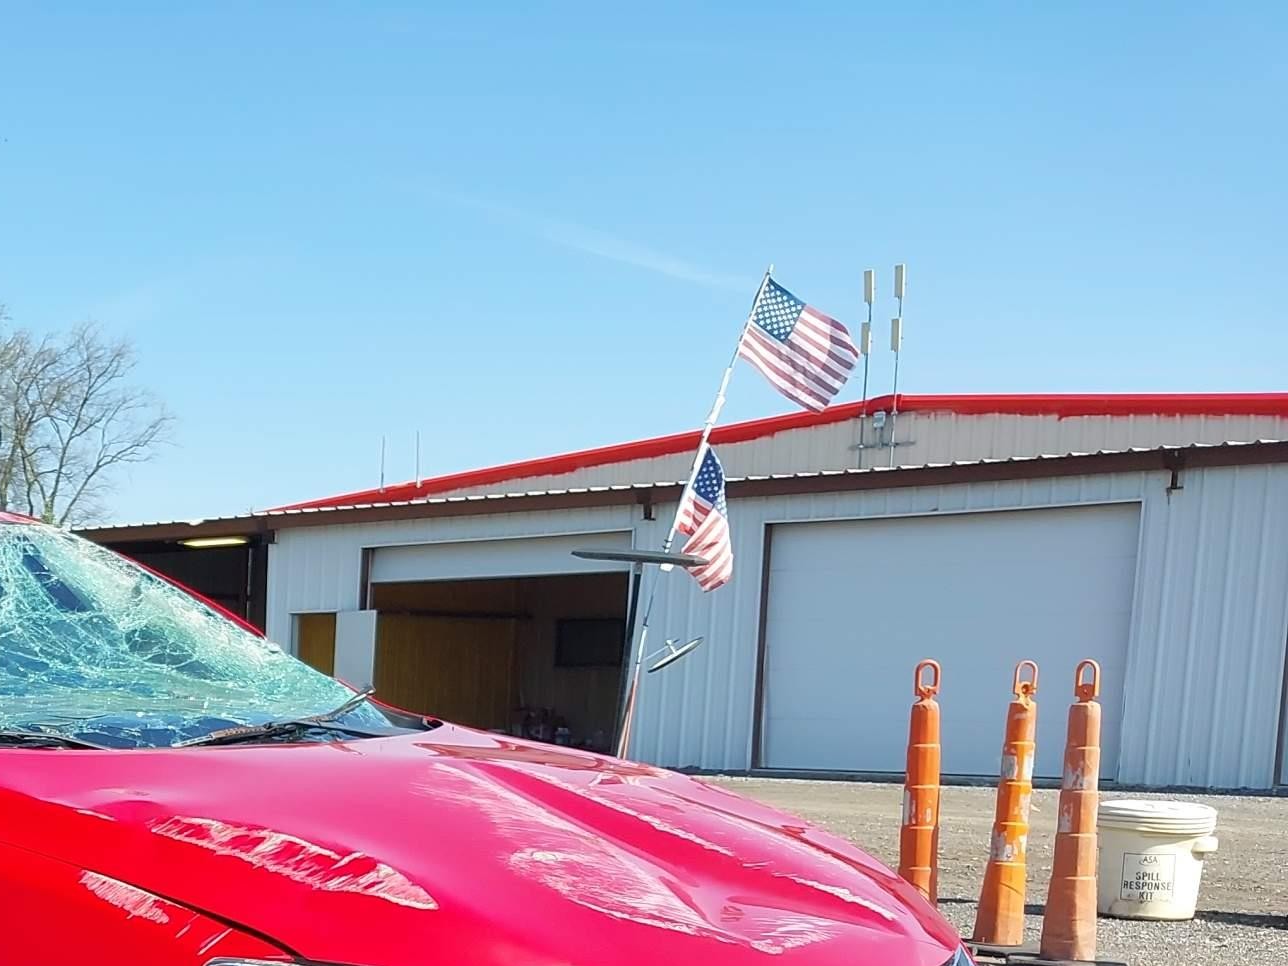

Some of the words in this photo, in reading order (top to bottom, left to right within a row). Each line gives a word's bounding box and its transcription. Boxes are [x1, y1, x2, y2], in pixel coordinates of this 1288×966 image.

[1135, 871, 1160, 881] SPILL
[1123, 880, 1172, 891] RESPONSE
[1138, 891, 1154, 900] KIT
